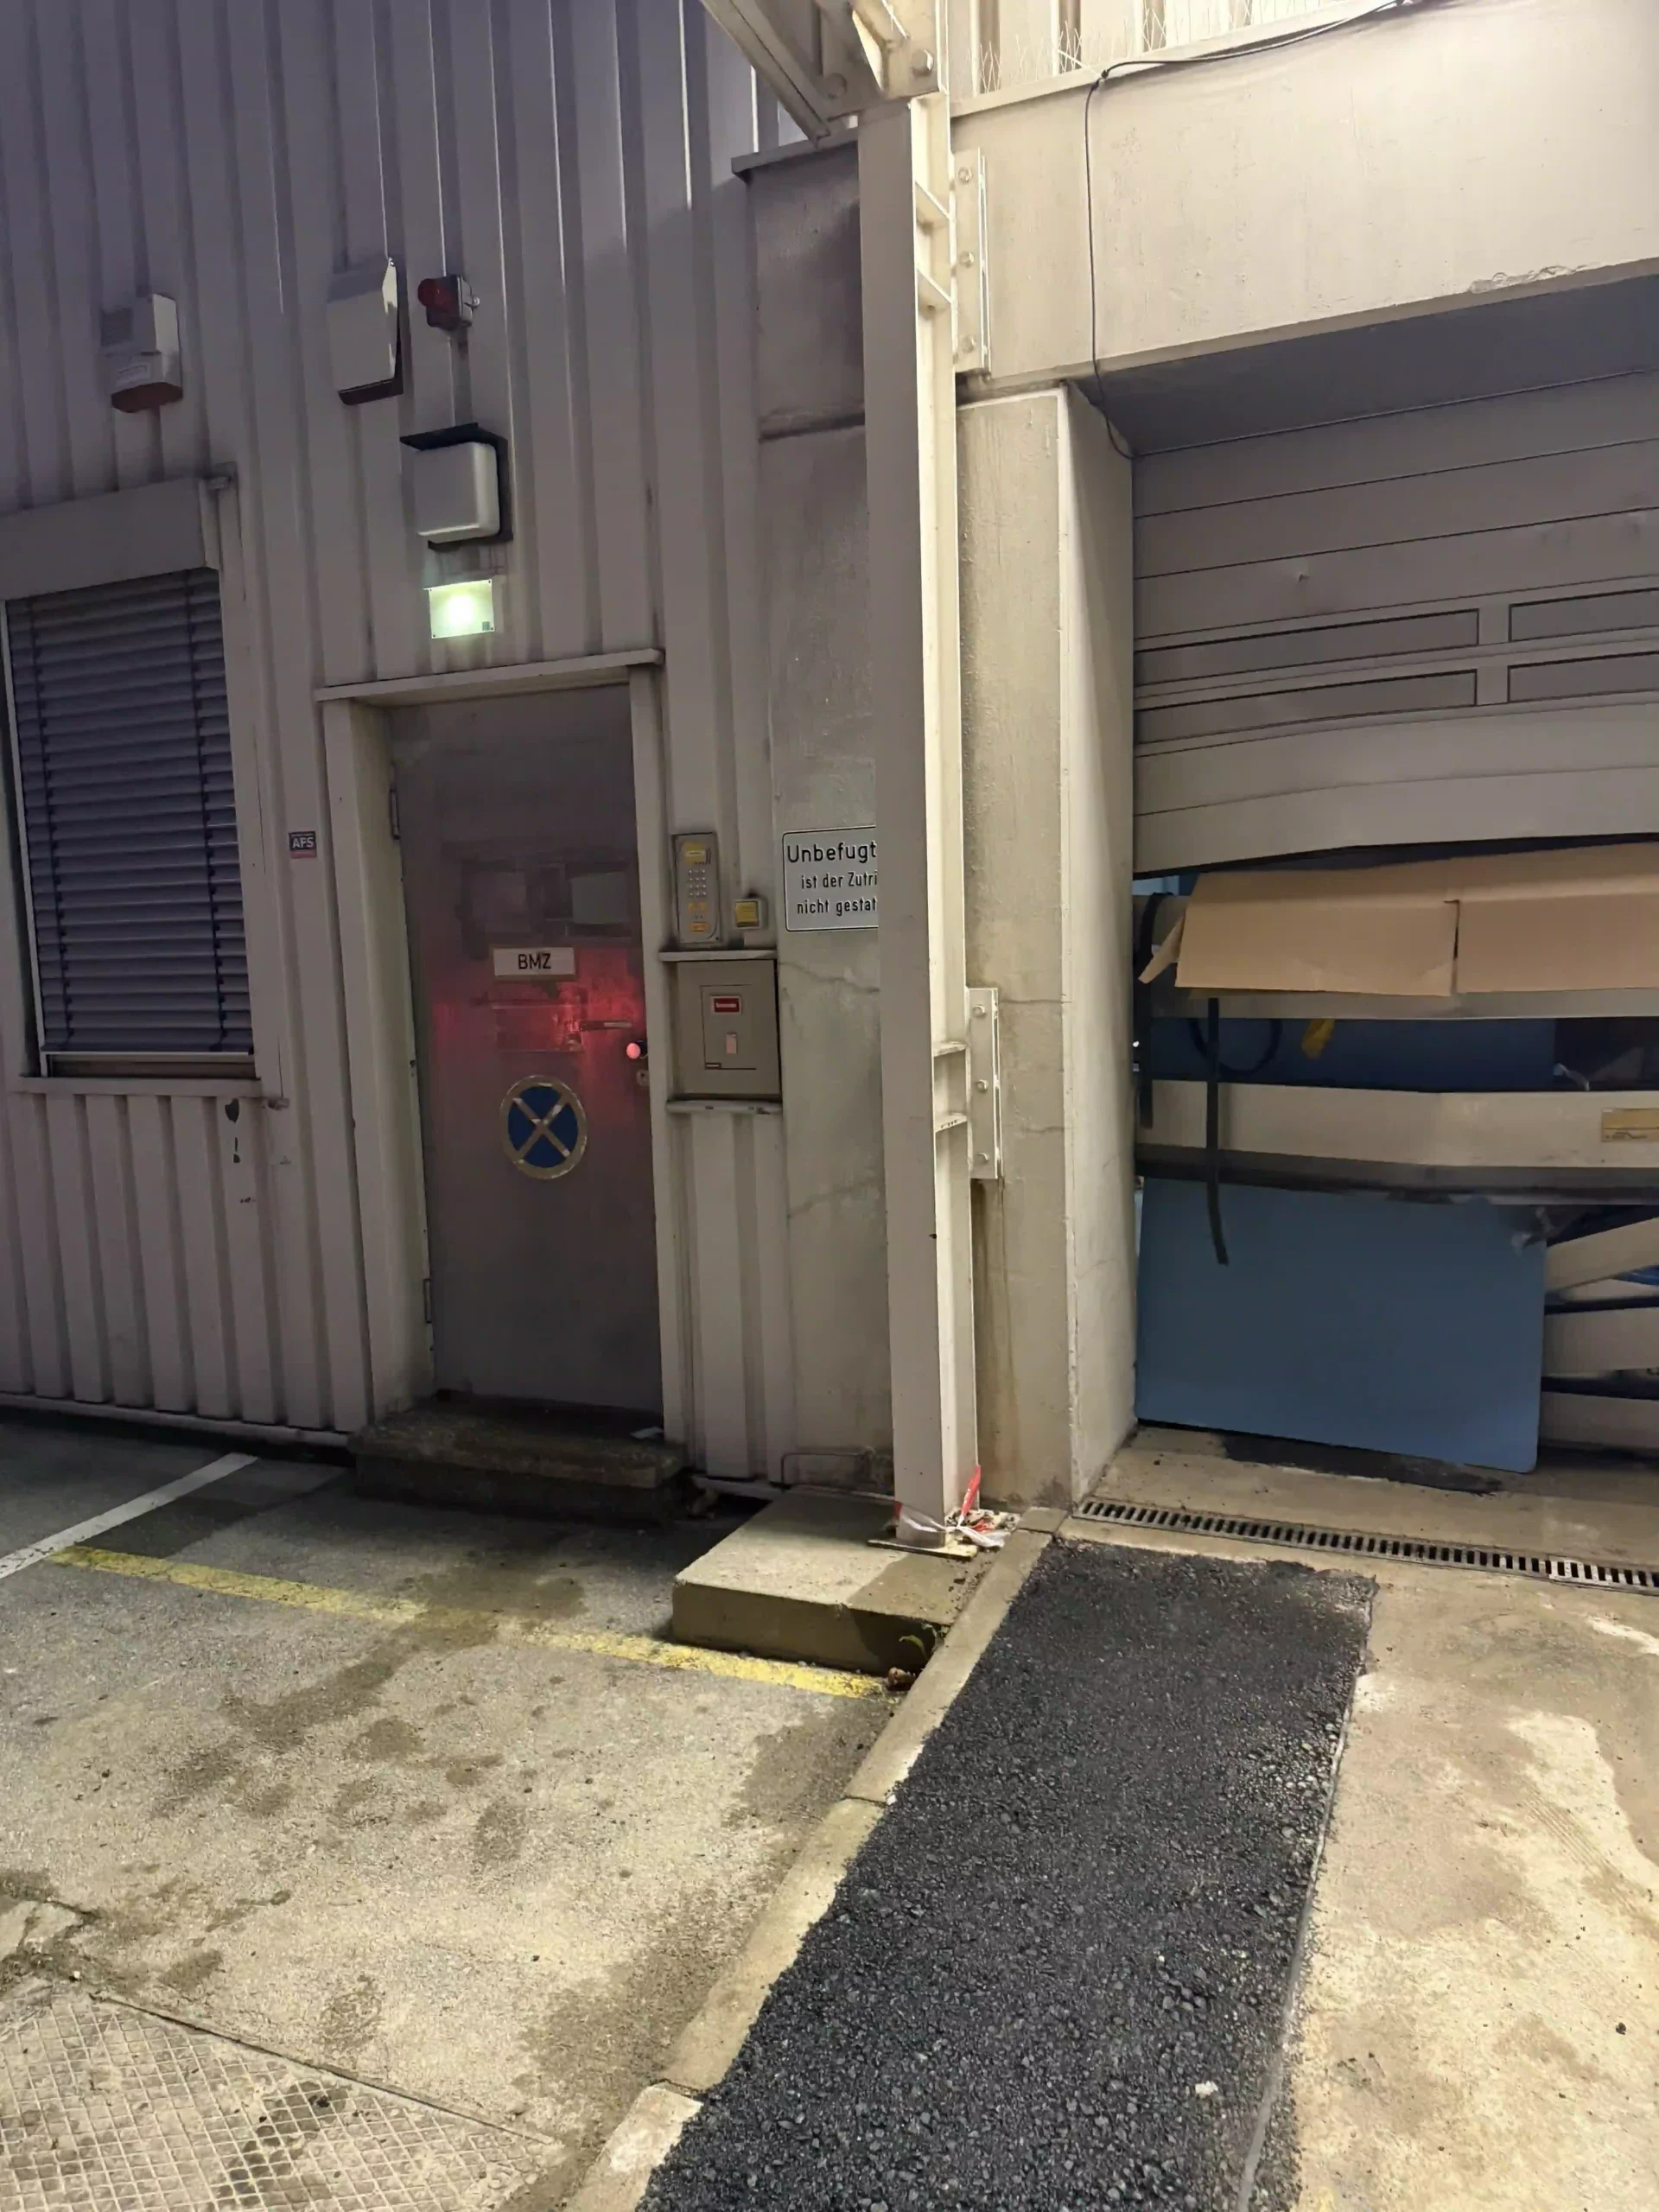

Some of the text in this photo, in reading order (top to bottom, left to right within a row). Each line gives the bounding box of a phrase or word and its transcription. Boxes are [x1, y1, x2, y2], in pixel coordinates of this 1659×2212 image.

[787, 841, 876, 863] Unbefugt
[801, 870, 877, 889] ist der Zutri
[797, 897, 876, 917] nicht gestat
[518, 953, 551, 969] BMZ
